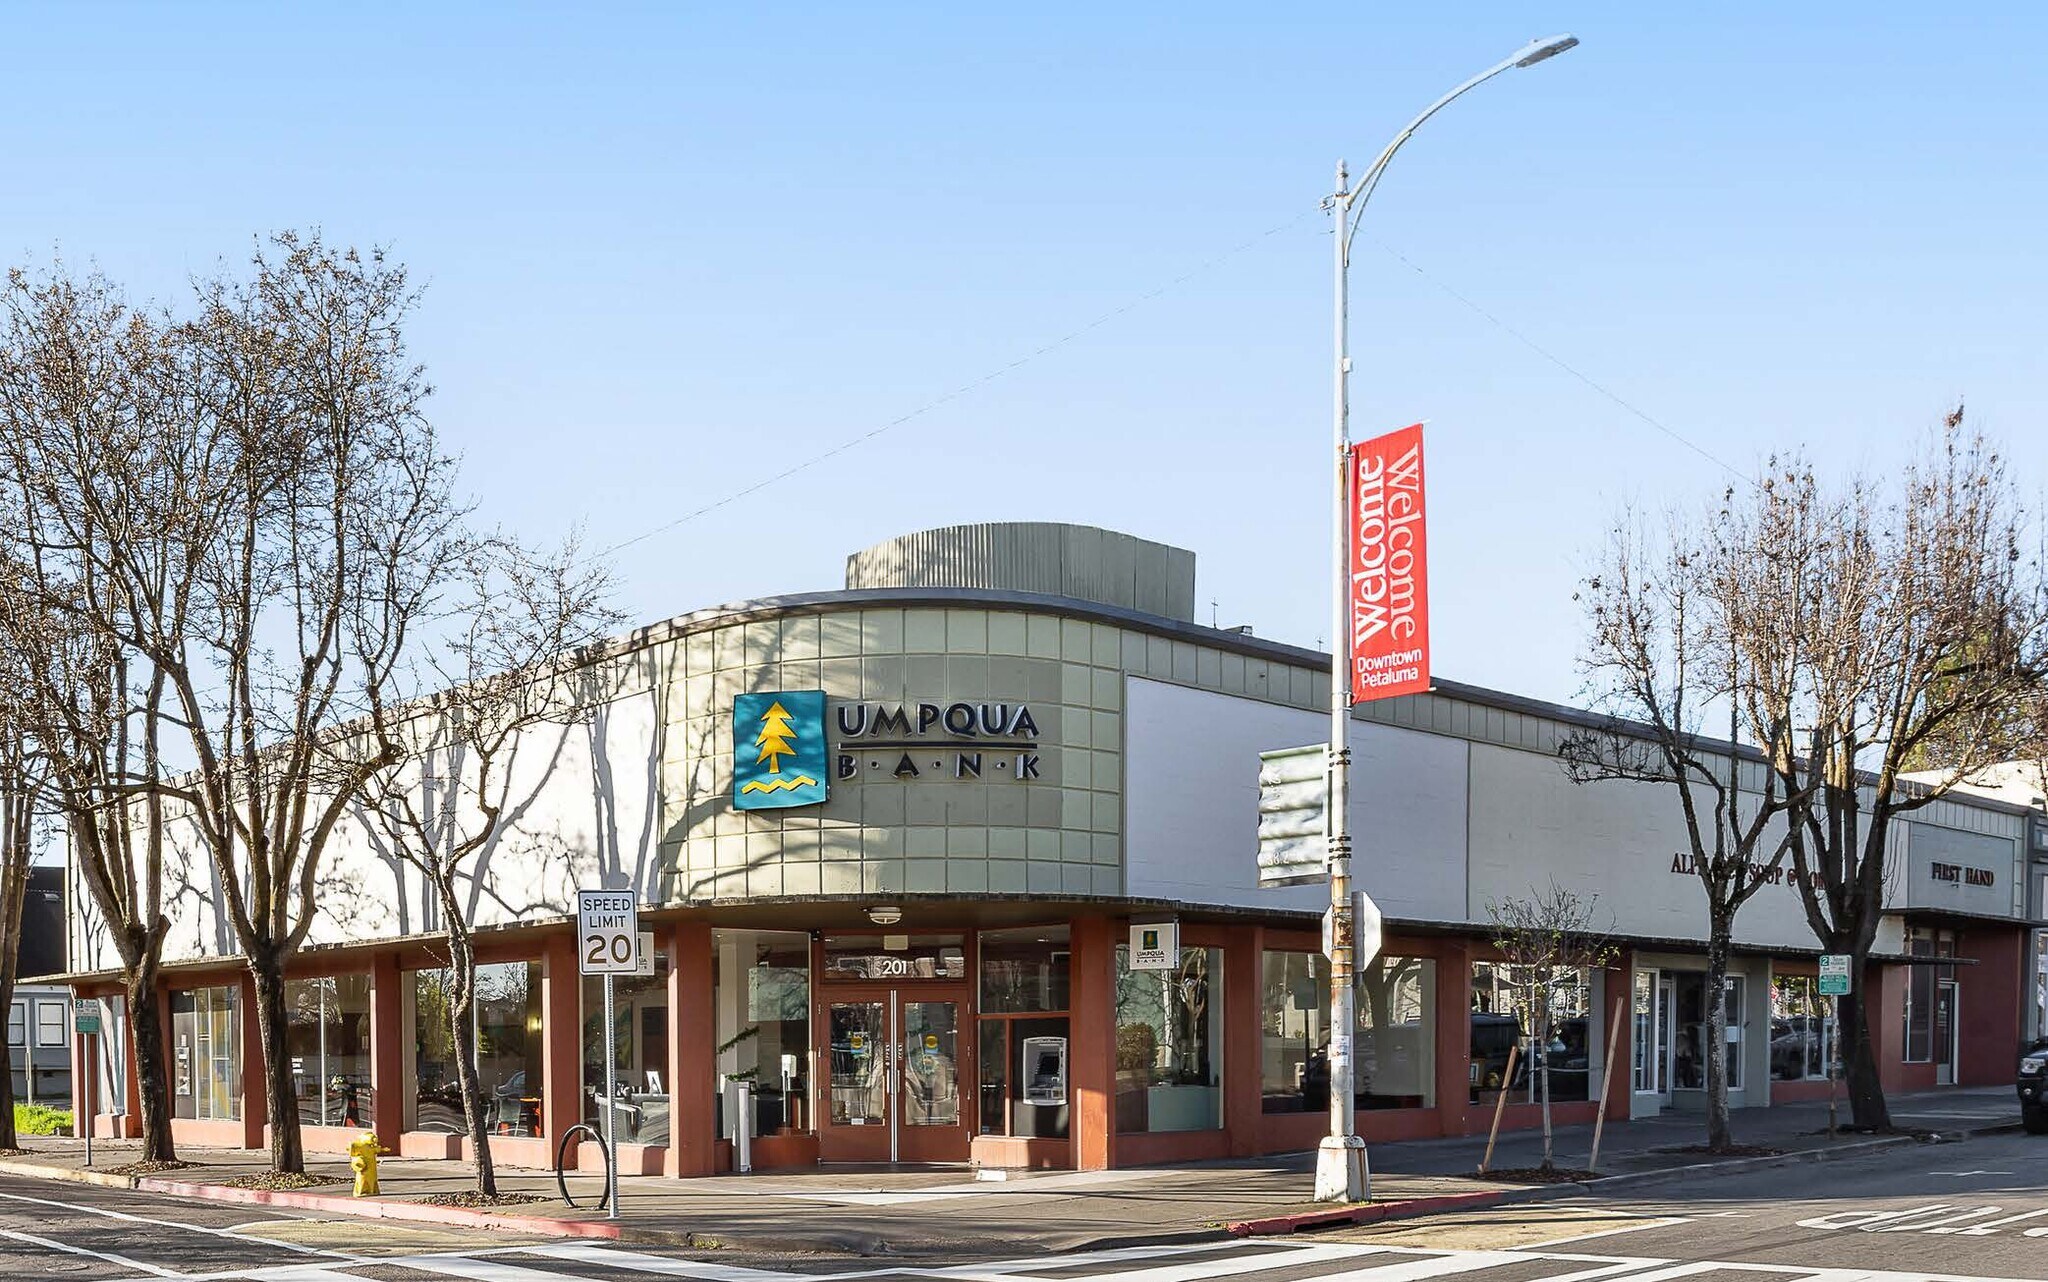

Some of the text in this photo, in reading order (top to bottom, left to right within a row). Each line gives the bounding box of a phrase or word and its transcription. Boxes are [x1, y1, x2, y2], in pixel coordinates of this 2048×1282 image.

[1353, 455, 1388, 648] Welcome
[1386, 443, 1422, 640] Welcome
[1357, 648, 1422, 673] Downtown
[1361, 666, 1419, 689] Petaluma
[838, 703, 1040, 739] UMPQUA
[1931, 862, 1994, 887] FIRST HAND
[583, 899, 631, 911] SPEED
[589, 915, 626, 928] LIMIT
[586, 934, 631, 964] 20
[1821, 957, 1828, 966] 2
[882, 960, 907, 975] 201
[1796, 1204, 2048, 1237] TOP
